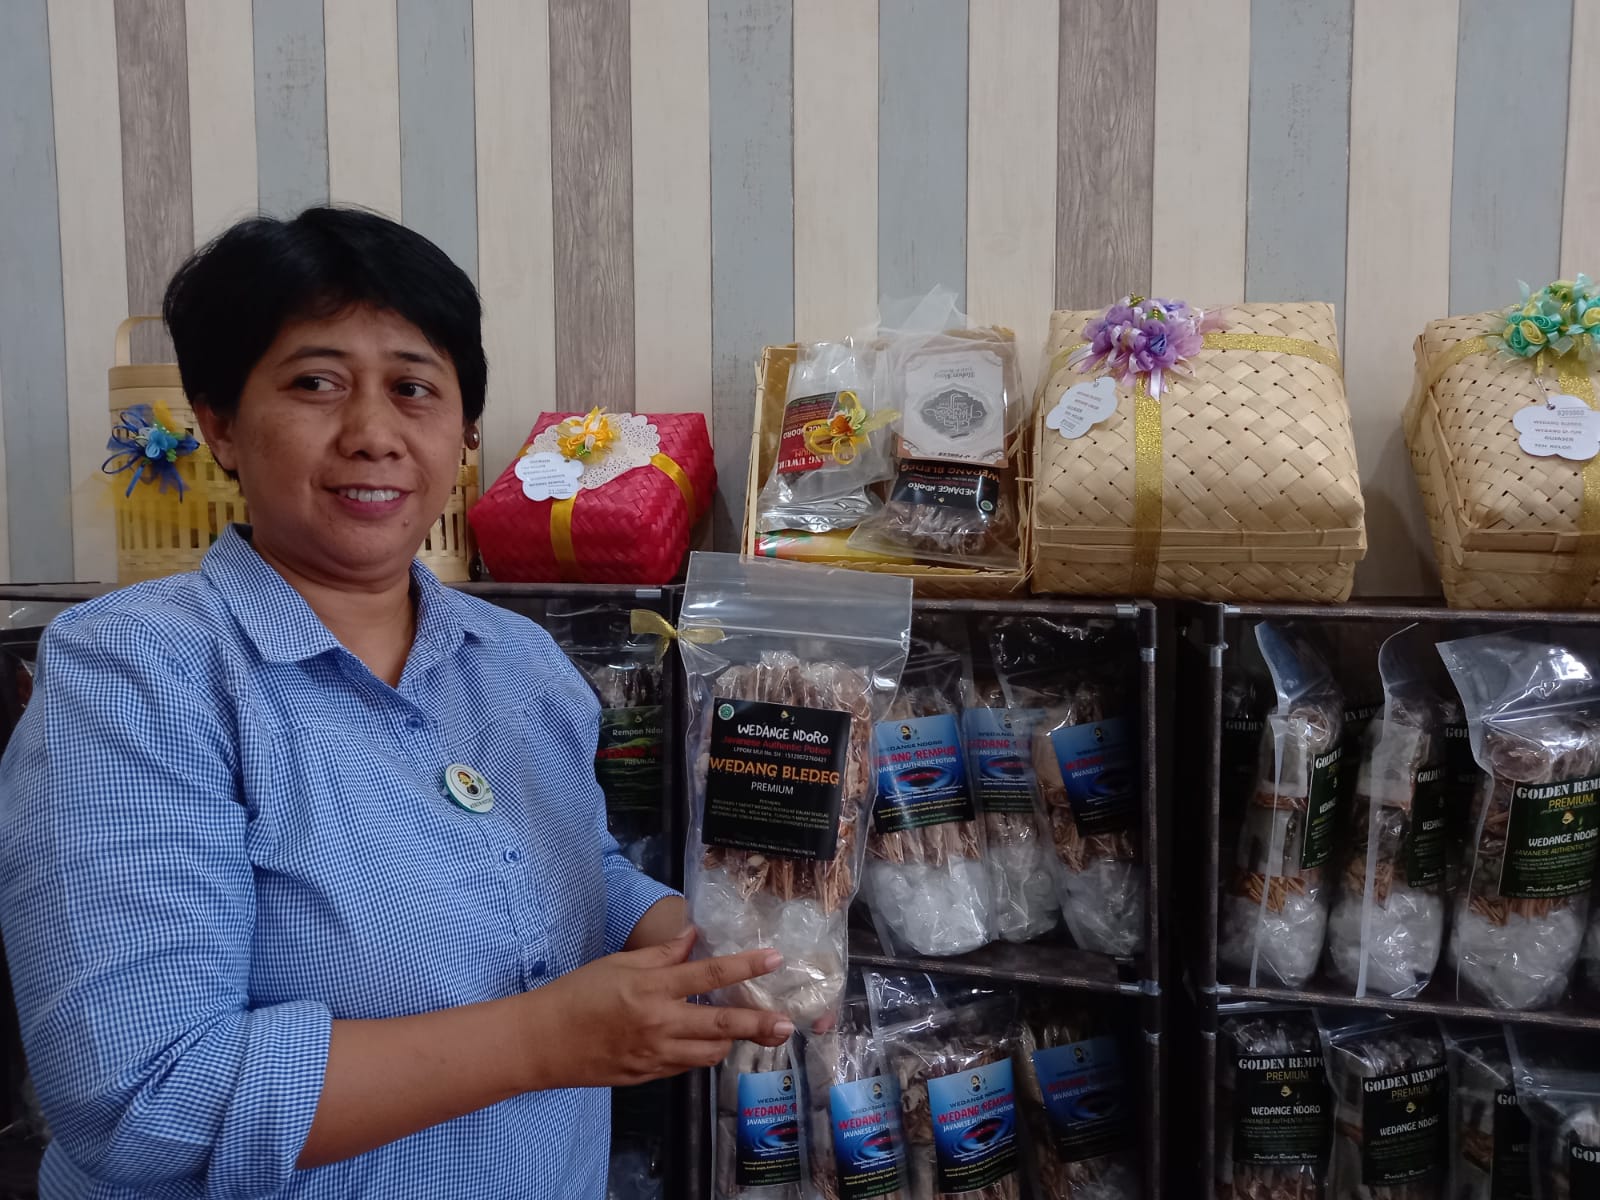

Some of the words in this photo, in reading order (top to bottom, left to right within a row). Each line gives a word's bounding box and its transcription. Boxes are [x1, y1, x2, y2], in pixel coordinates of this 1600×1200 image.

[737, 724, 790, 740] WEDANGE
[709, 757, 778, 778] WEDANG
[782, 765, 840, 785] BLEDEG
[751, 781, 795, 795] PREMIUM
[1516, 783, 1570, 800] GOLDEN
[1548, 793, 1595, 810] PREMIUM
[1528, 832, 1572, 847] WEDANGE
[1238, 1058, 1285, 1070] GOLDEN
[1266, 1071, 1309, 1081] PREMIUM
[1364, 1074, 1409, 1093] GOLDEN
[742, 1103, 788, 1117] WEDANG
[937, 1106, 979, 1125] WEDANG
[1251, 1106, 1292, 1116] WEDANGE
[1293, 1105, 1321, 1115] NDORO
[838, 1114, 881, 1130] WEDANG
[1380, 1120, 1417, 1137] WEDANGE
